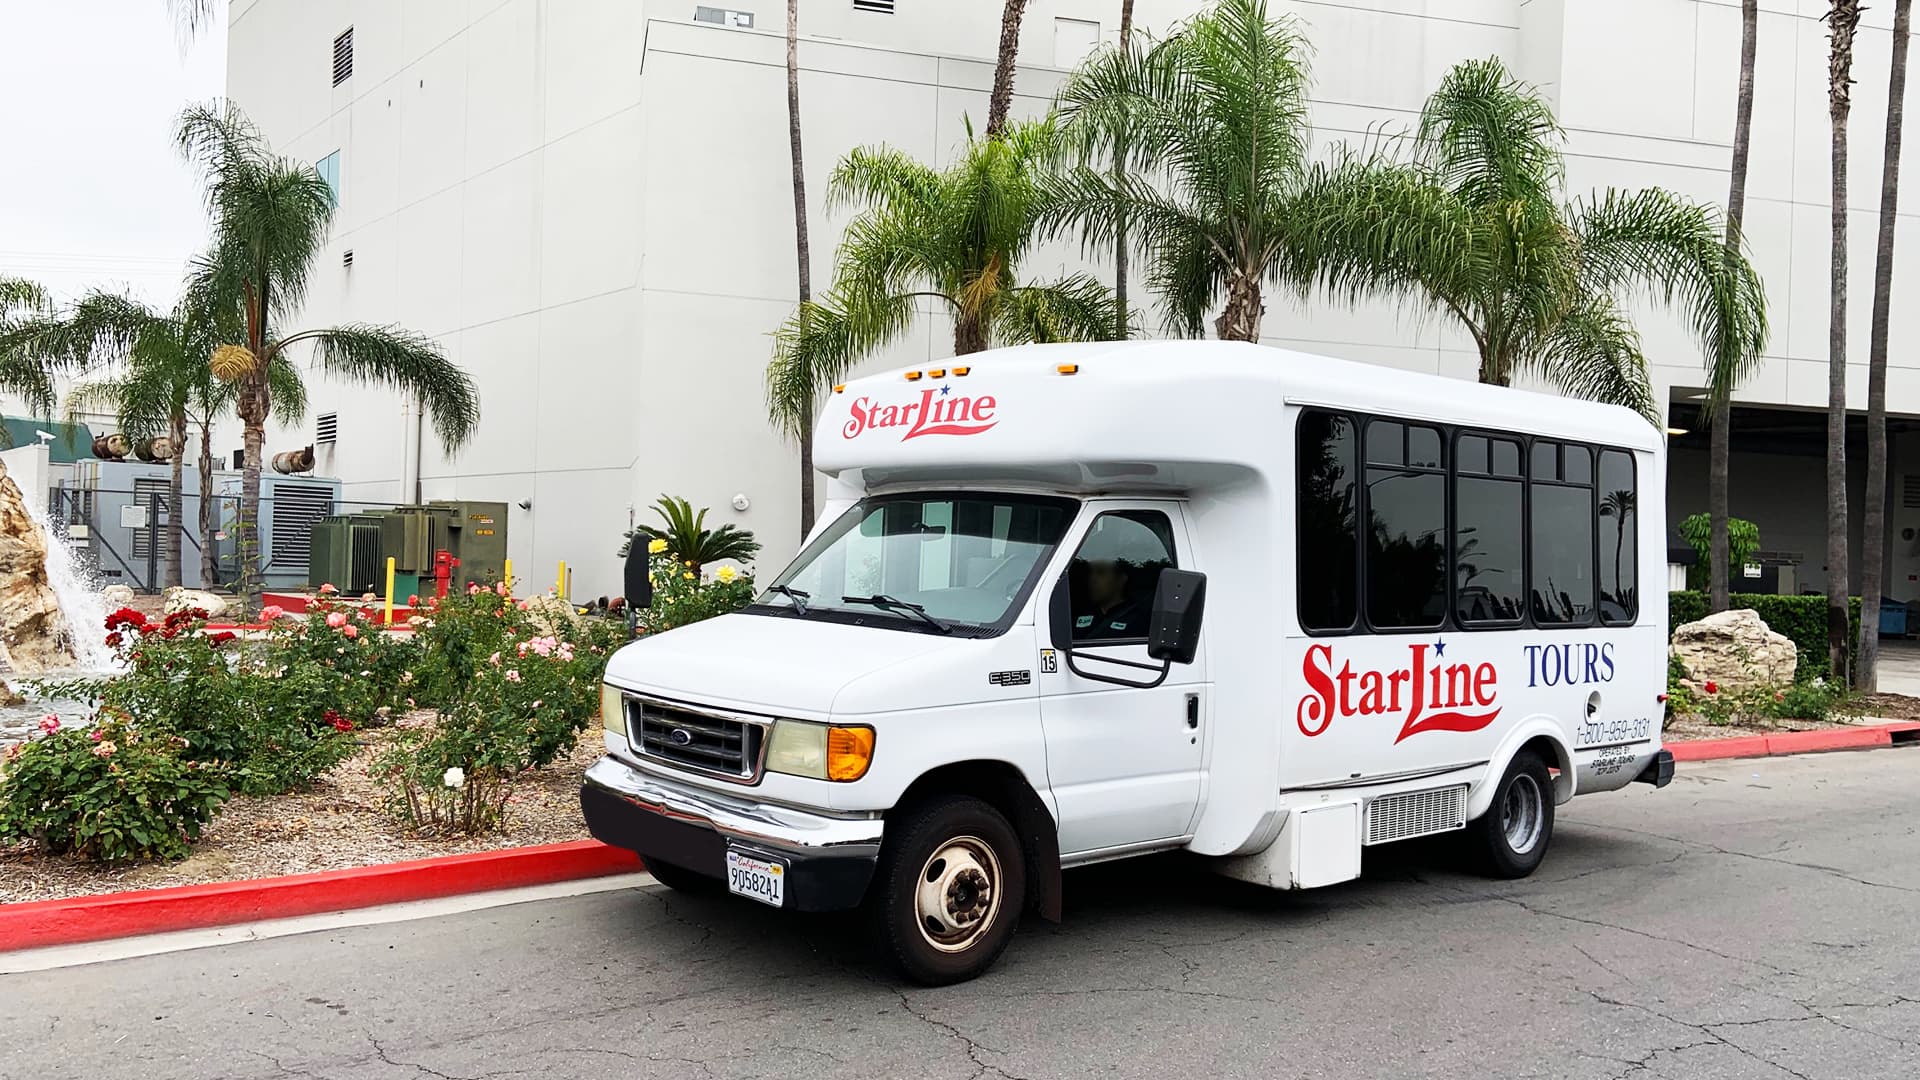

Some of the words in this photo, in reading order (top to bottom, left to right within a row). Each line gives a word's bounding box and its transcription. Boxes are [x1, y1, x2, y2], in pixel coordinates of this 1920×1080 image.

[842, 386, 1000, 442] StarLine
[1043, 656, 1055, 670] 15
[1297, 639, 1502, 746] StarLine
[1523, 642, 1615, 688] TOURS
[1576, 718, 1650, 745] 1-800-959-3131
[1590, 757, 1617, 768] STARLINE
[1618, 754, 1636, 764] TOURS
[737, 856, 770, 871] California
[732, 868, 779, 899] 90582A1
